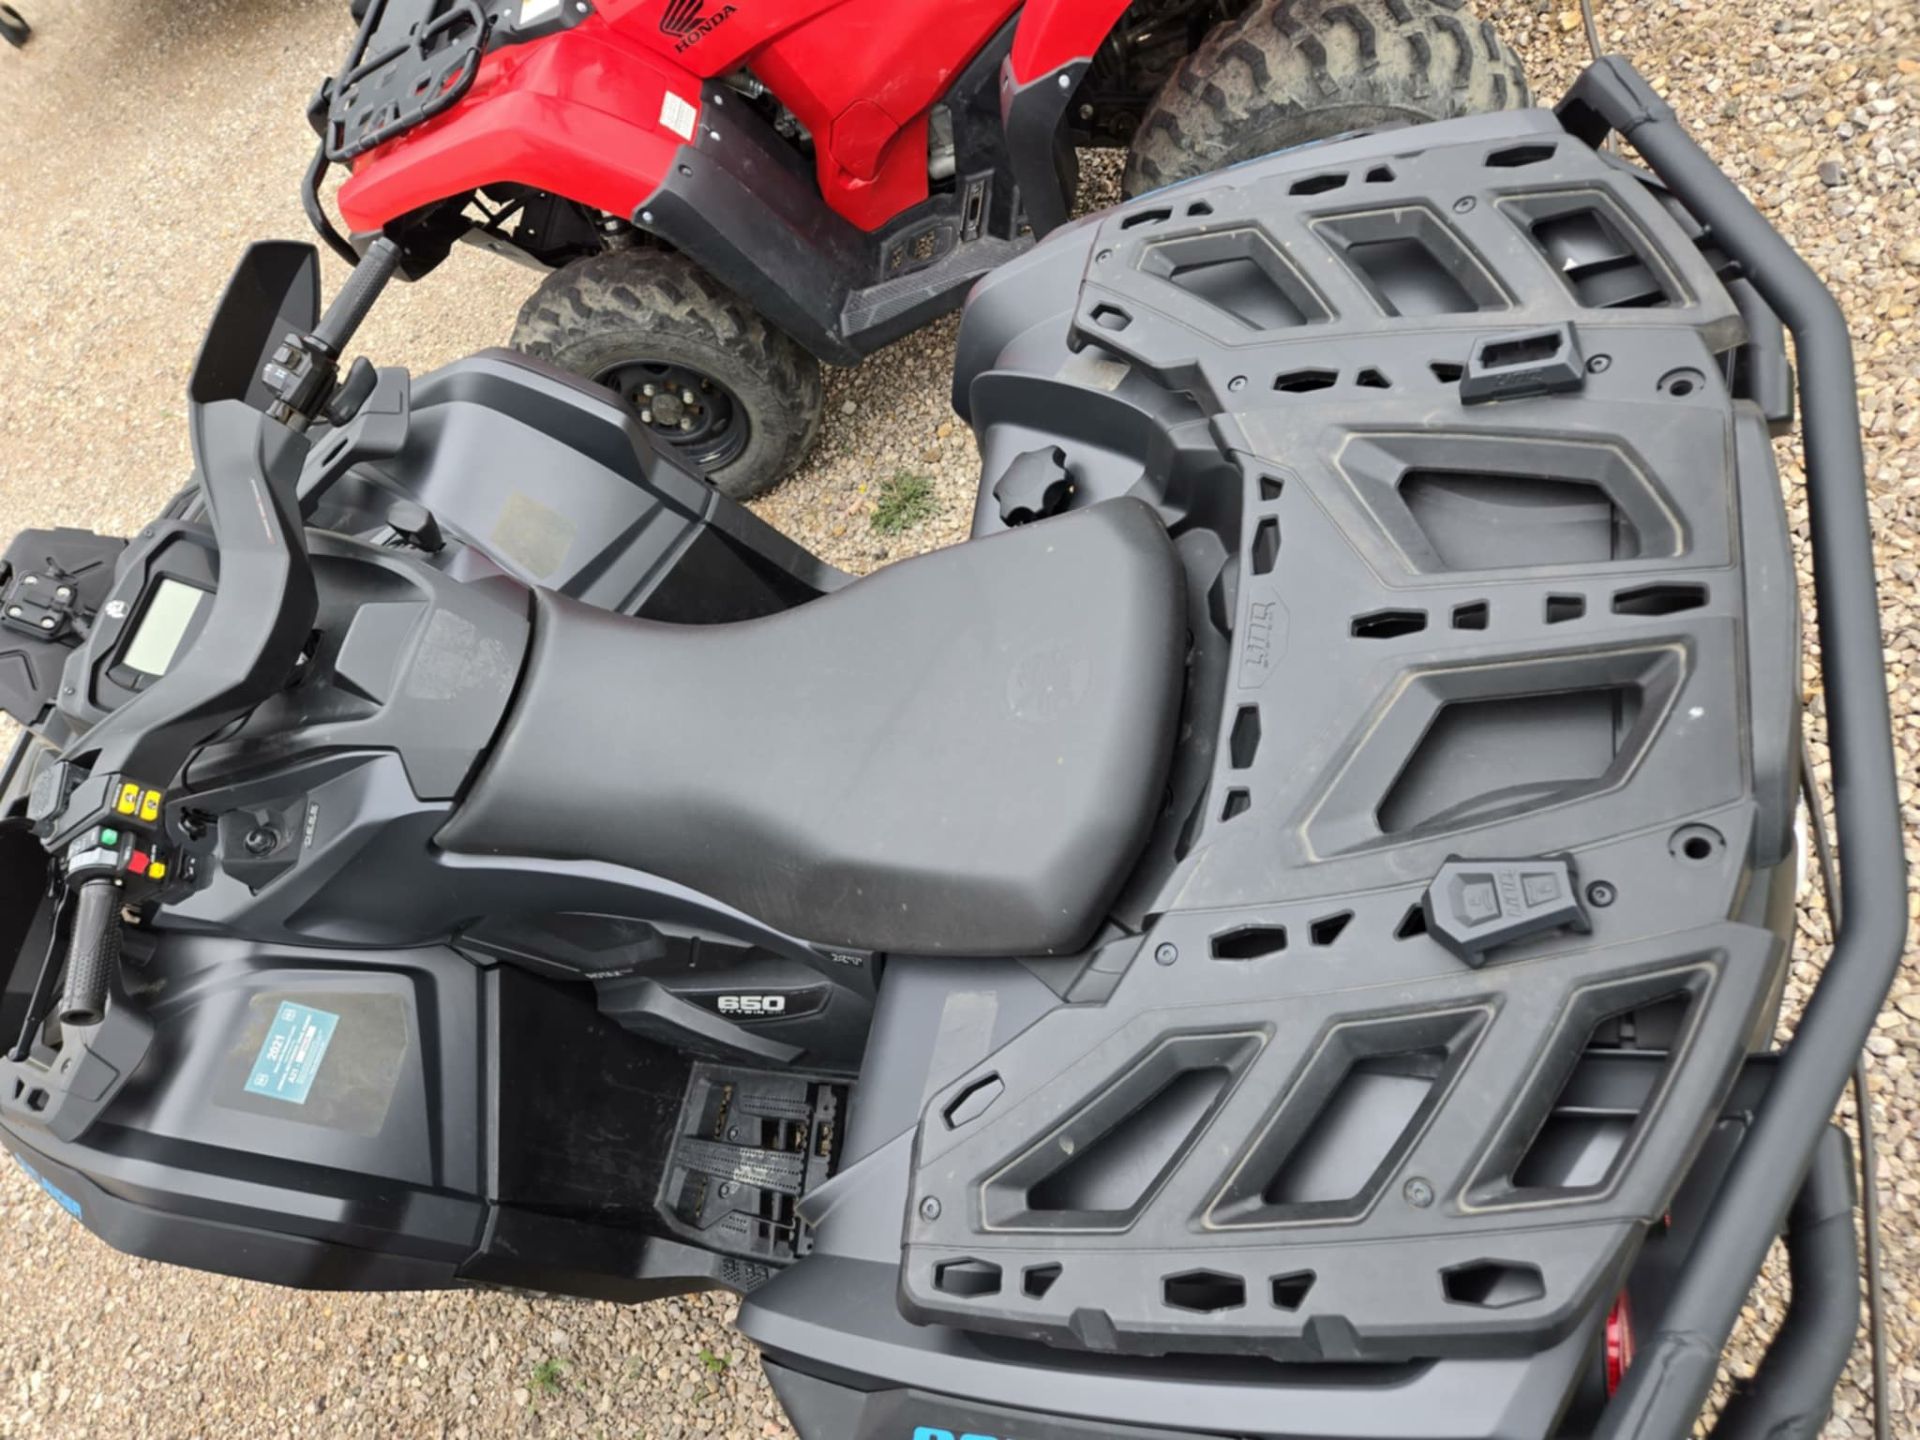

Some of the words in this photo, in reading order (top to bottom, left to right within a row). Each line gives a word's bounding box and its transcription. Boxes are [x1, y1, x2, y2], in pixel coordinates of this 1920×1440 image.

[674, 5, 737, 53] HONDA
[718, 995, 785, 1010] 650
[266, 1034, 285, 1061] 2021
